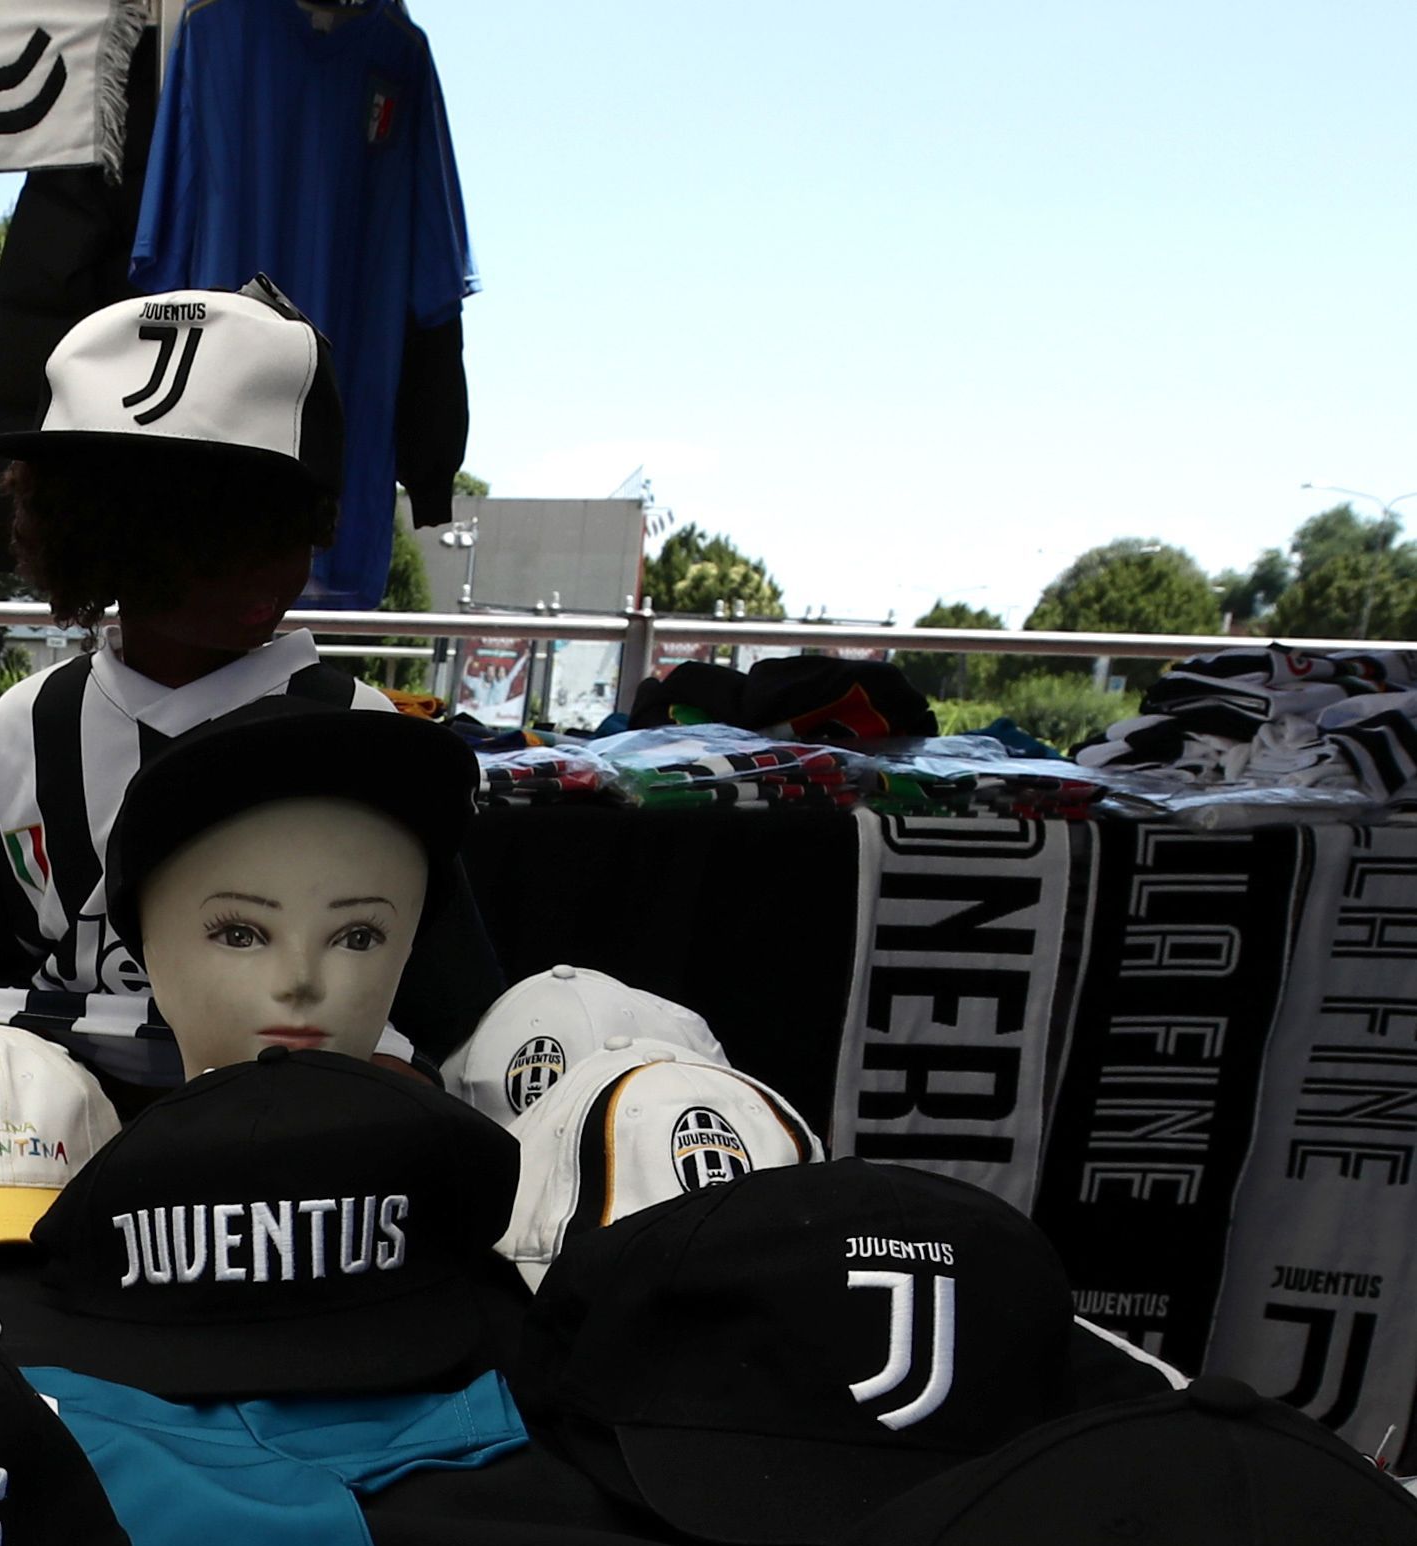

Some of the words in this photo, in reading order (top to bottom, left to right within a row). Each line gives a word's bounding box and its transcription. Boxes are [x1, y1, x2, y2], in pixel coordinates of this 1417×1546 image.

[138, 302, 206, 321] JUVENTUS
[31, 912, 151, 997] Je
[513, 1052, 561, 1070] JUVENTUS
[677, 1133, 741, 1151] JUVENTUS
[112, 1194, 409, 1289] JUVENTUS
[846, 1236, 955, 1266] JUVENTUS
[1270, 1265, 1384, 1299] JUVENTUS
